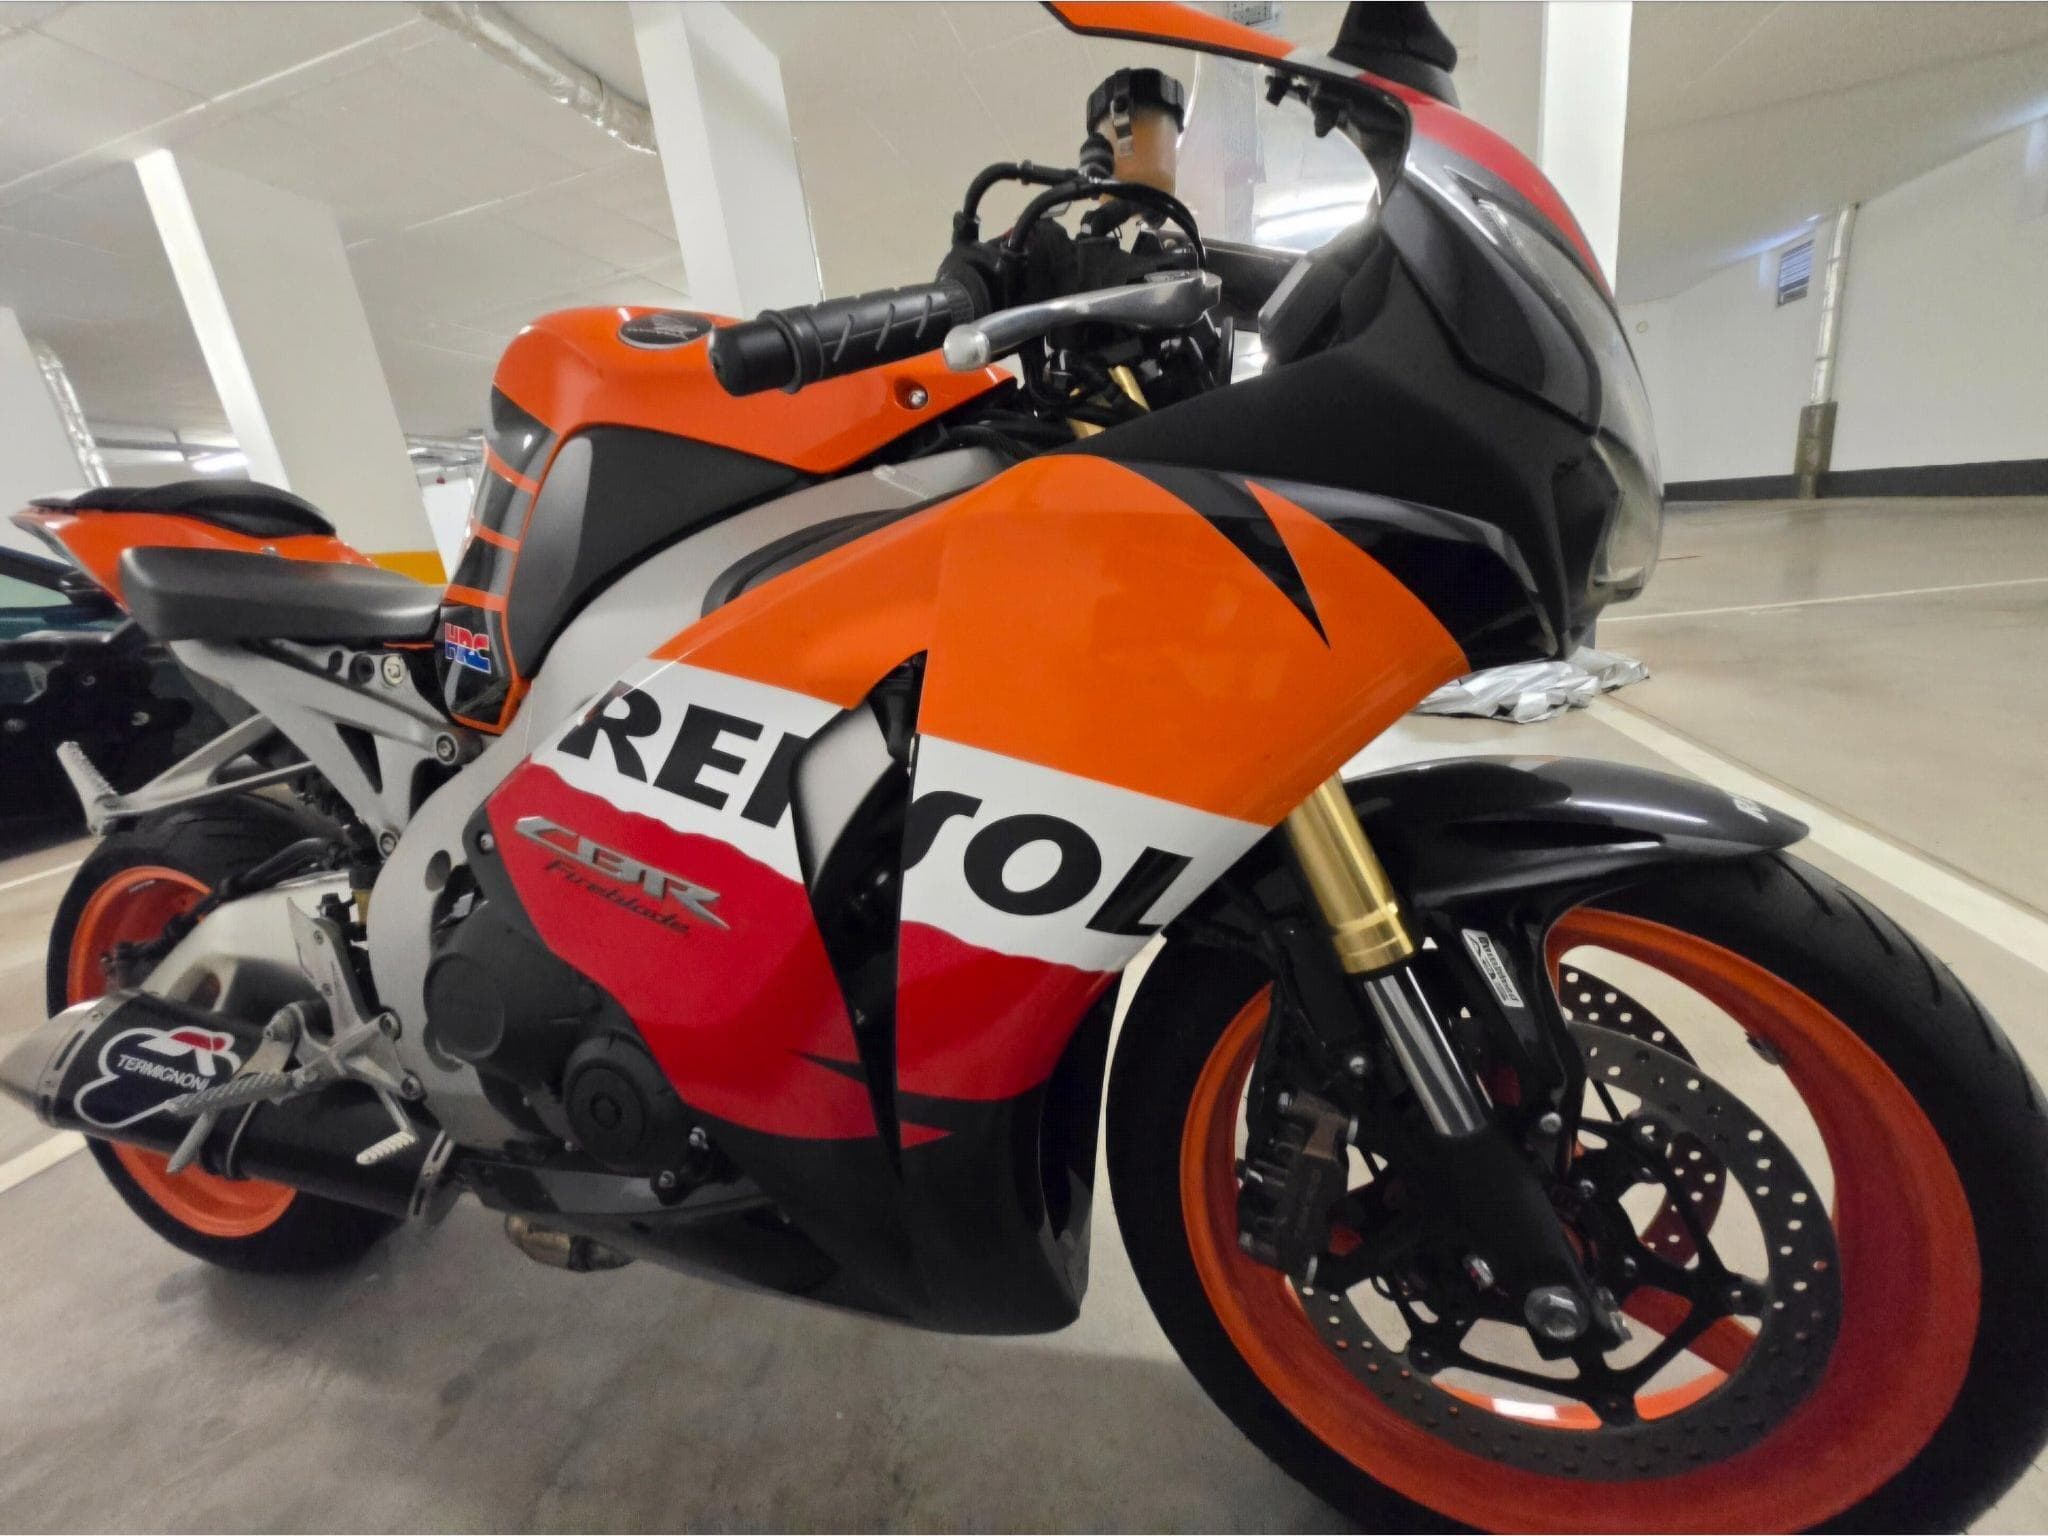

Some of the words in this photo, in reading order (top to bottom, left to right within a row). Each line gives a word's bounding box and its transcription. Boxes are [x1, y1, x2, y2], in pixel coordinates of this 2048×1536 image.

[444, 622, 492, 674] HRC
[514, 815, 732, 931] CBR
[544, 859, 690, 935] Fireblade
[116, 1053, 211, 1093] TERMIGNONI
